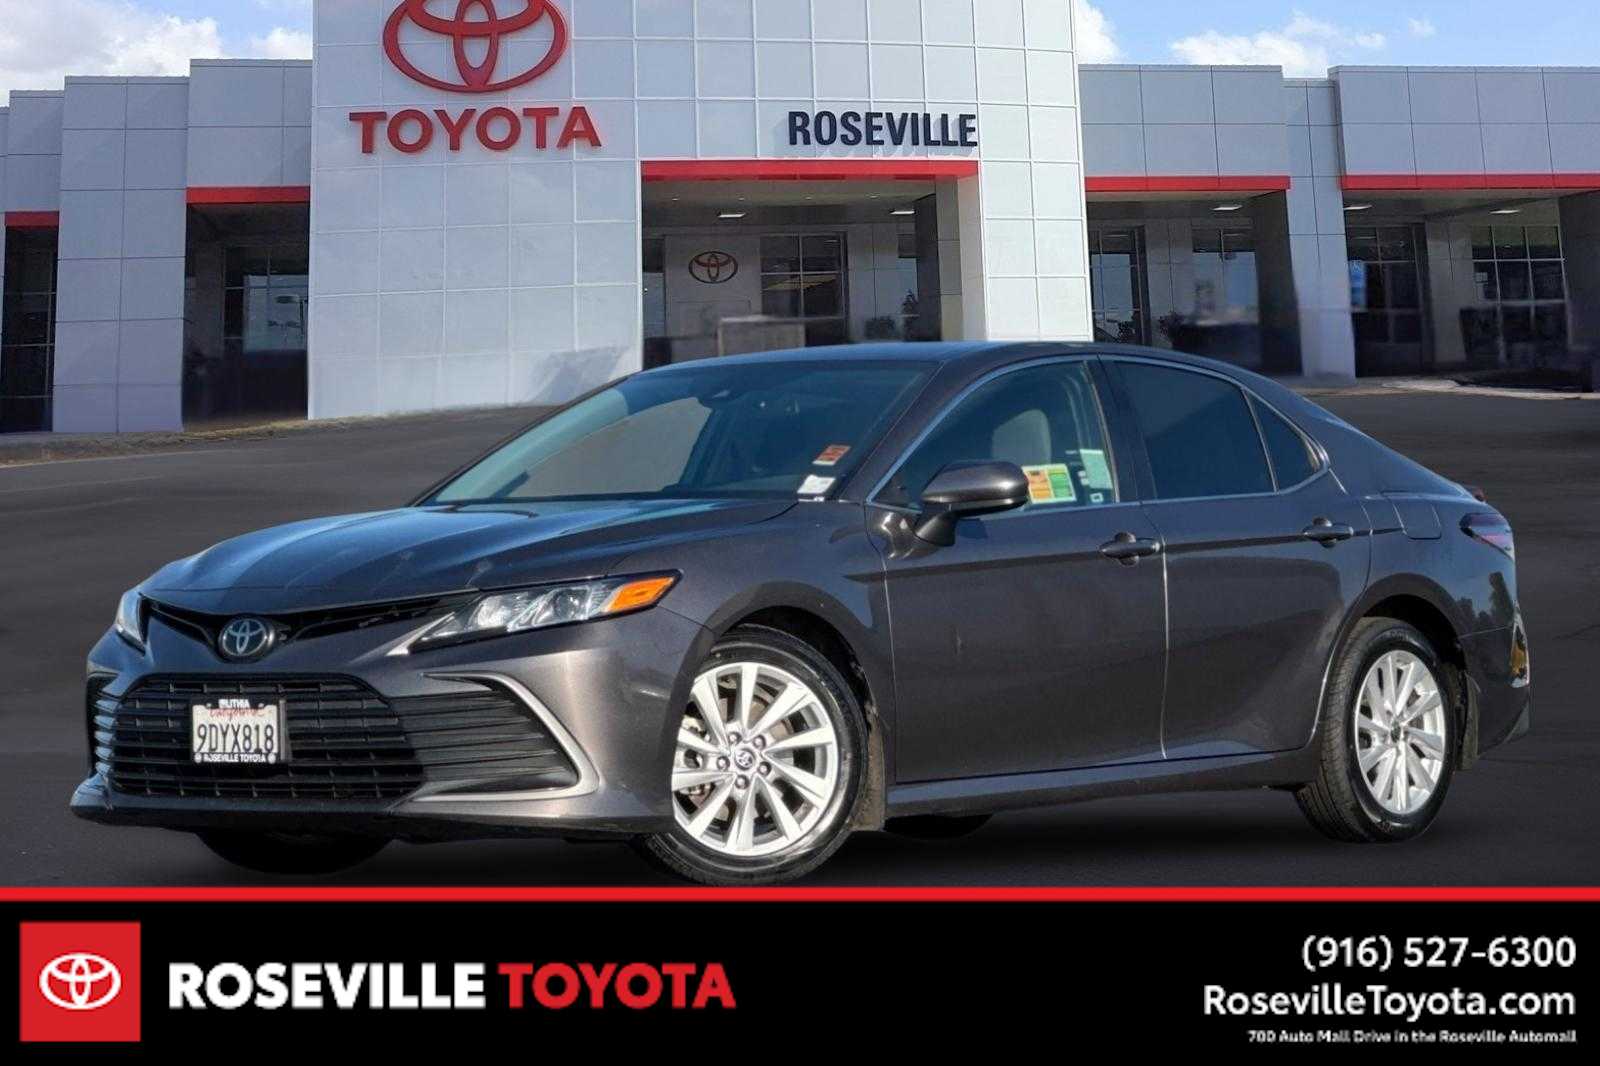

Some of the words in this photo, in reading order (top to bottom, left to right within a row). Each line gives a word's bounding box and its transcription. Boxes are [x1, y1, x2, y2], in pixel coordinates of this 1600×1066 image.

[350, 106, 602, 153] TOYOTA
[789, 111, 978, 147] ROSEVILLE
[197, 723, 274, 753] 9DYX818
[203, 753, 239, 762] ROSEVILLE
[240, 753, 266, 762] TOYOTA
